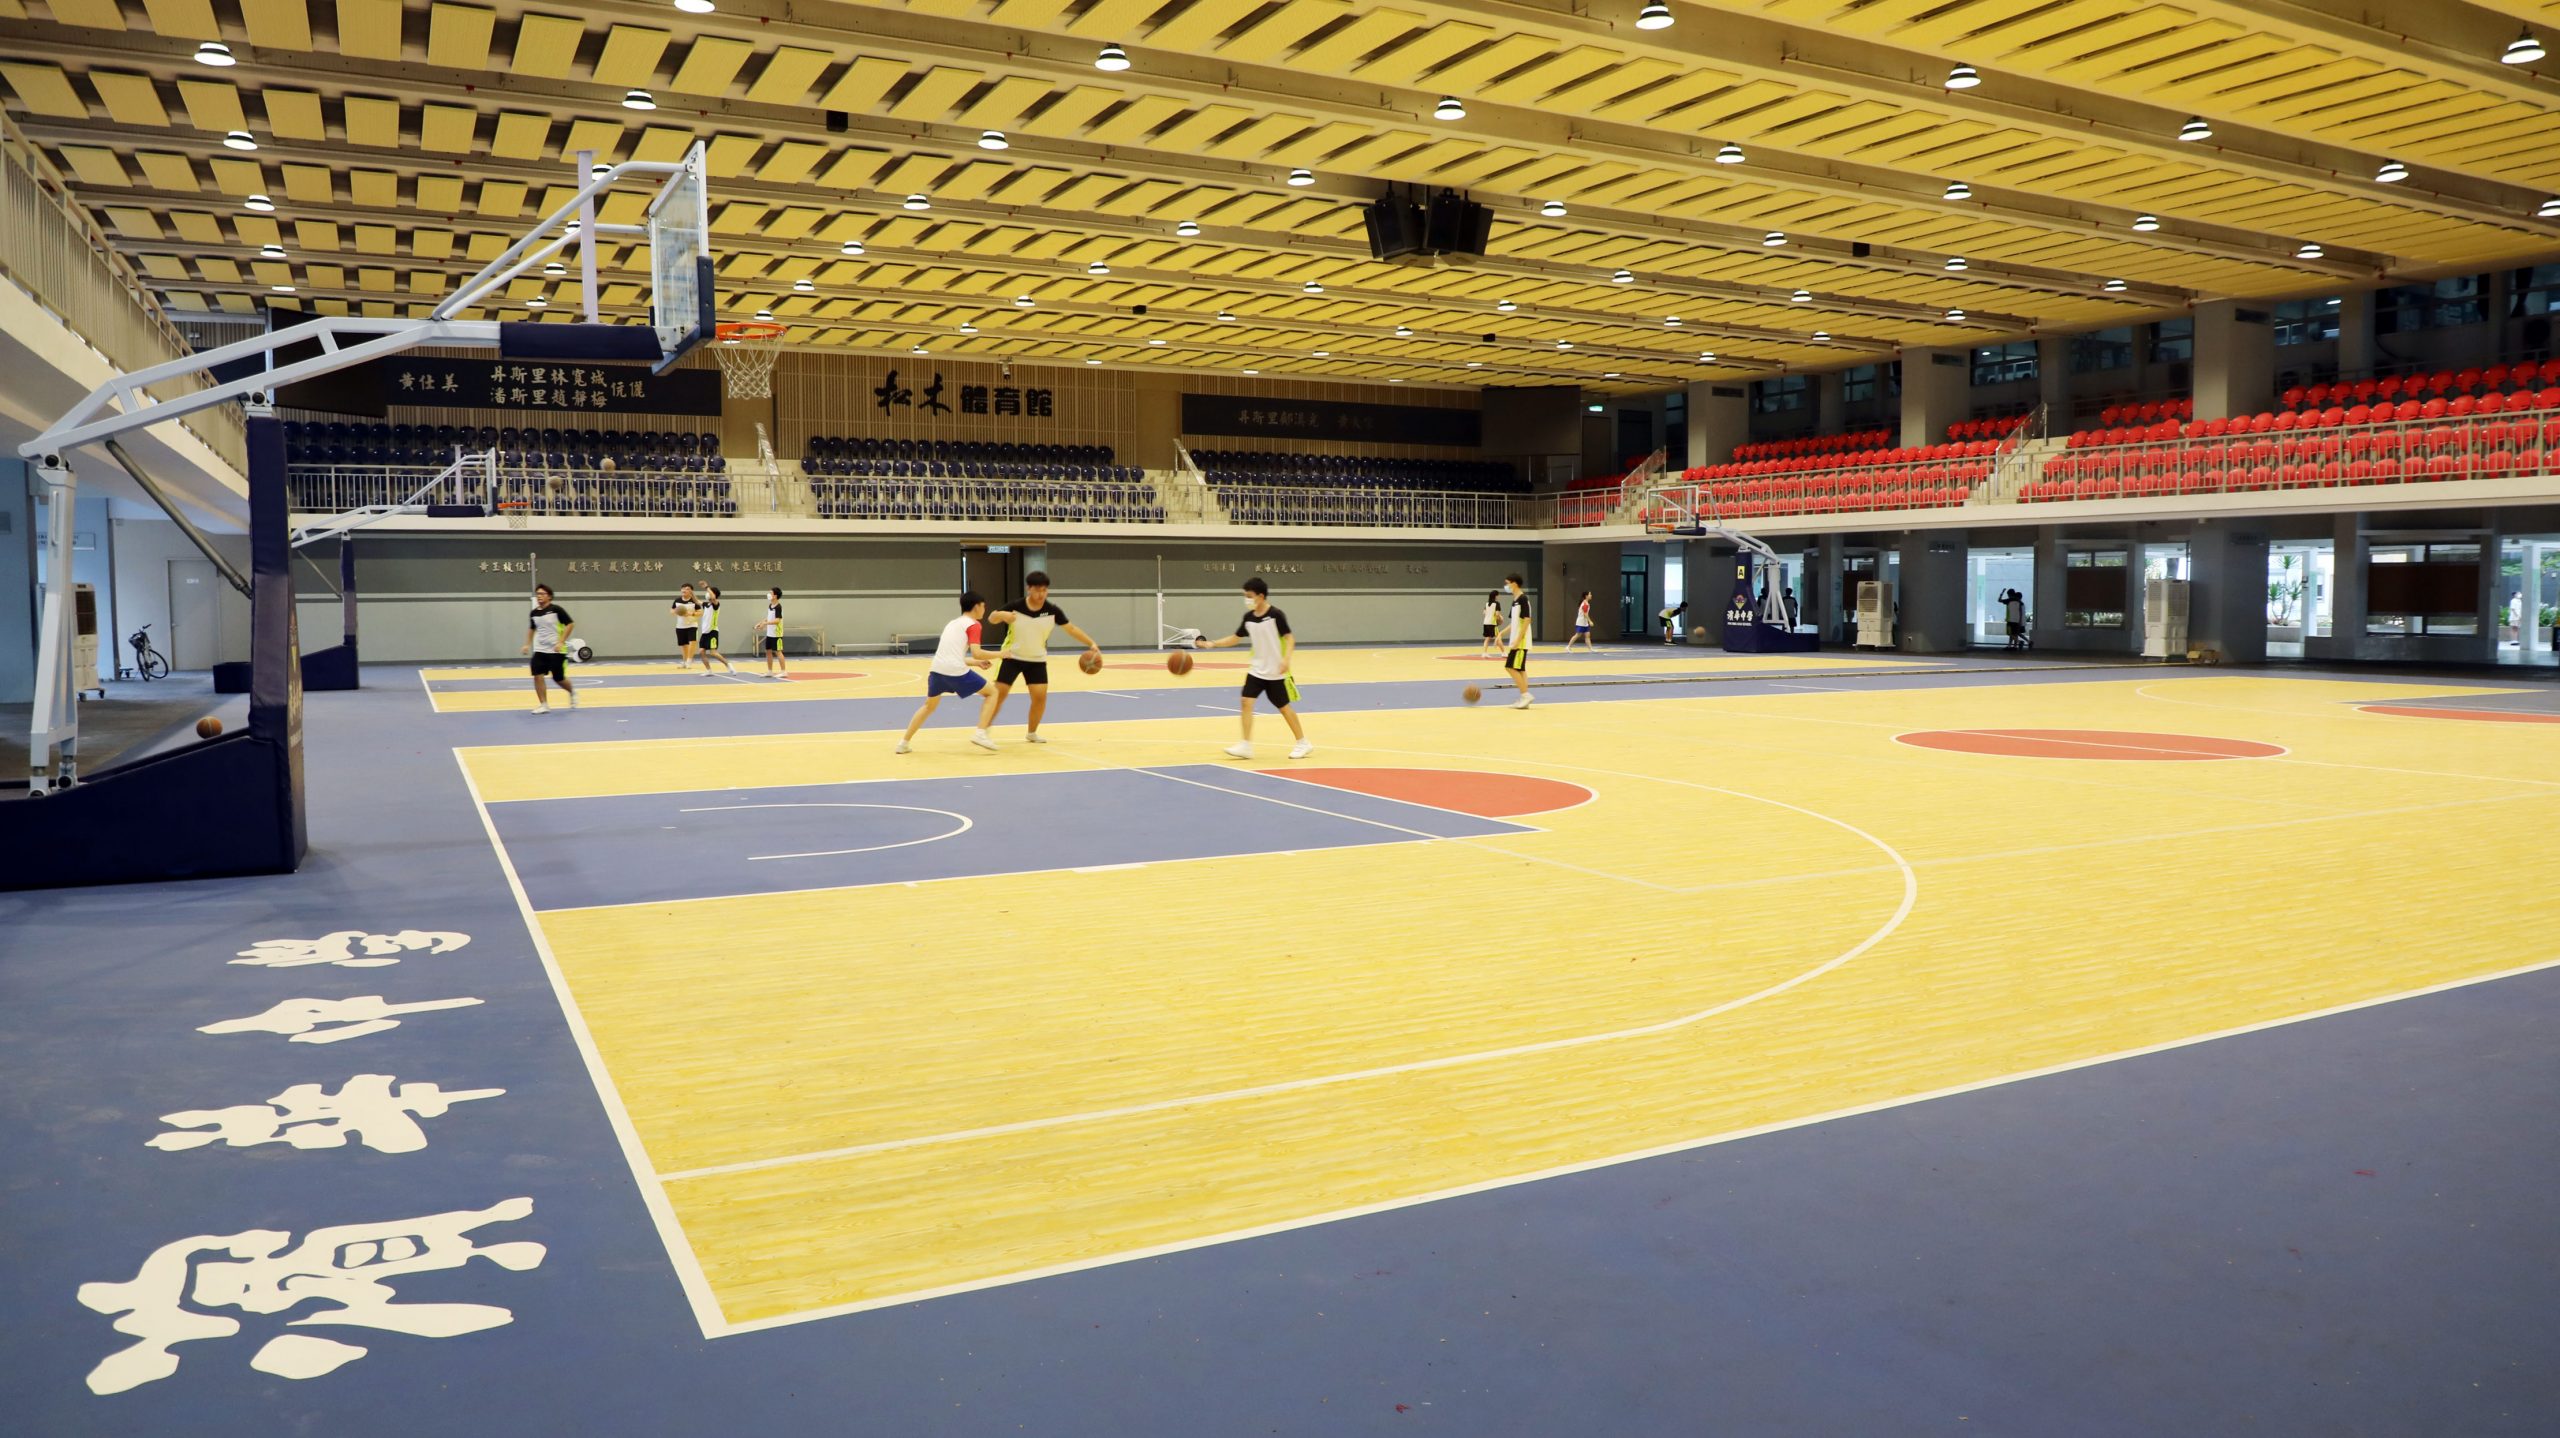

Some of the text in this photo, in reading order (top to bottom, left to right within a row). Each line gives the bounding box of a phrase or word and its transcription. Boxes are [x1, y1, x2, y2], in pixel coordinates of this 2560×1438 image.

[610, 380, 646, 399] 伉儷
[874, 369, 1053, 417] 松木體育館
